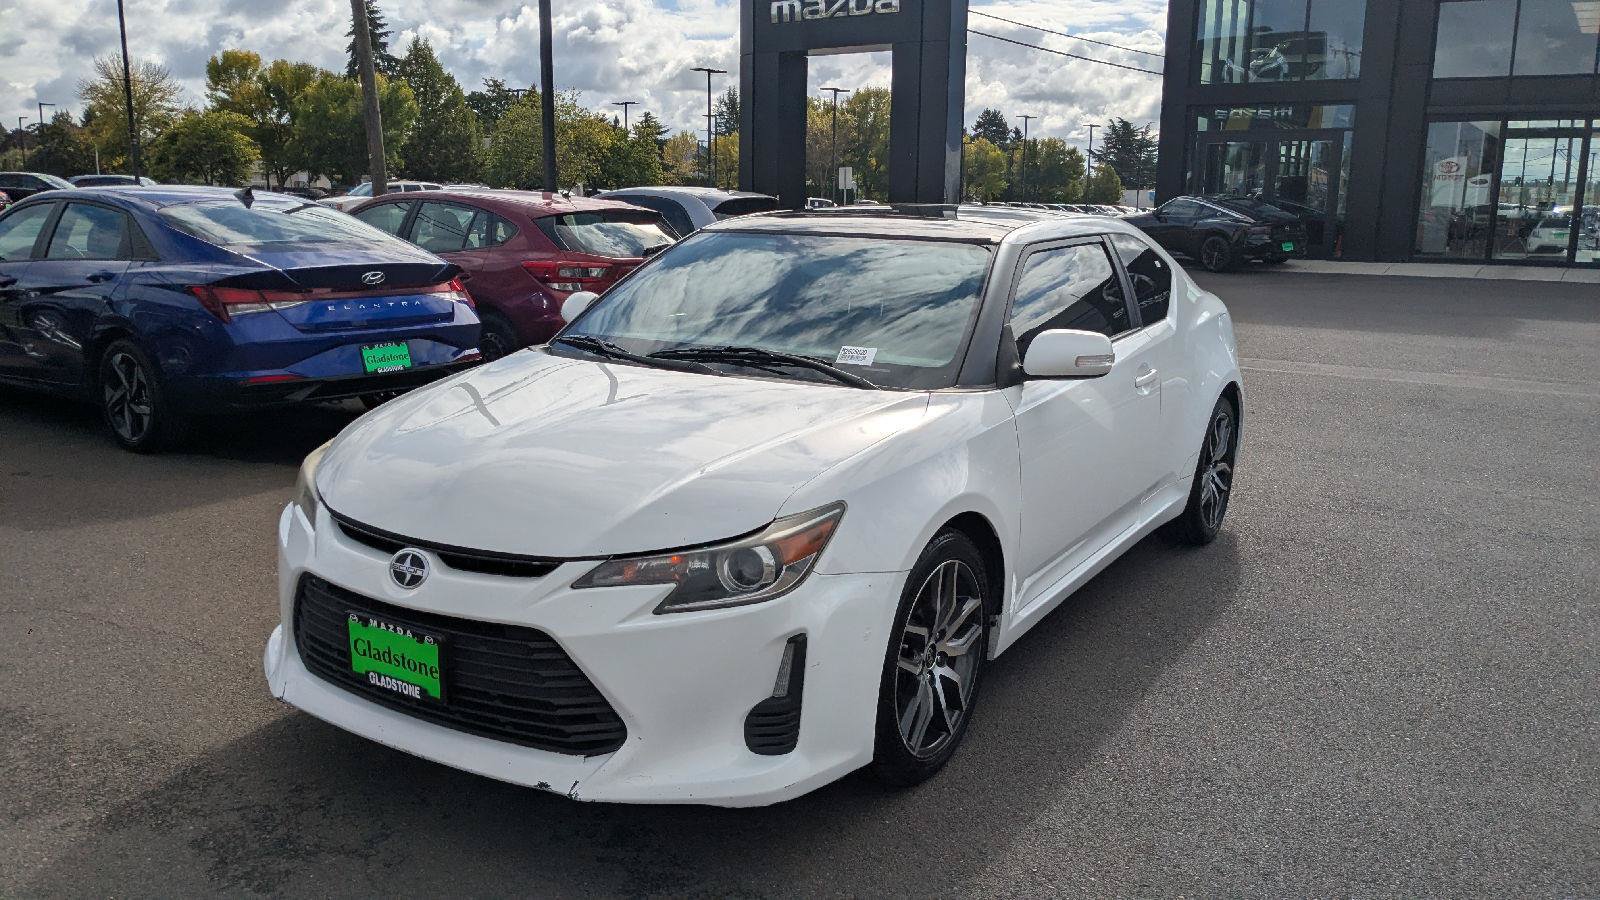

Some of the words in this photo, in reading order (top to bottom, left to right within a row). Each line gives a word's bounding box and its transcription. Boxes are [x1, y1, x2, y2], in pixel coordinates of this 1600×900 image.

[771, 0, 900, 24] mazda
[328, 301, 420, 311] ELANTRA
[366, 353, 409, 364] Gladstone
[369, 618, 413, 638] MAZDA
[353, 637, 439, 679] Gladstone
[368, 671, 421, 699] GLADSTONE
